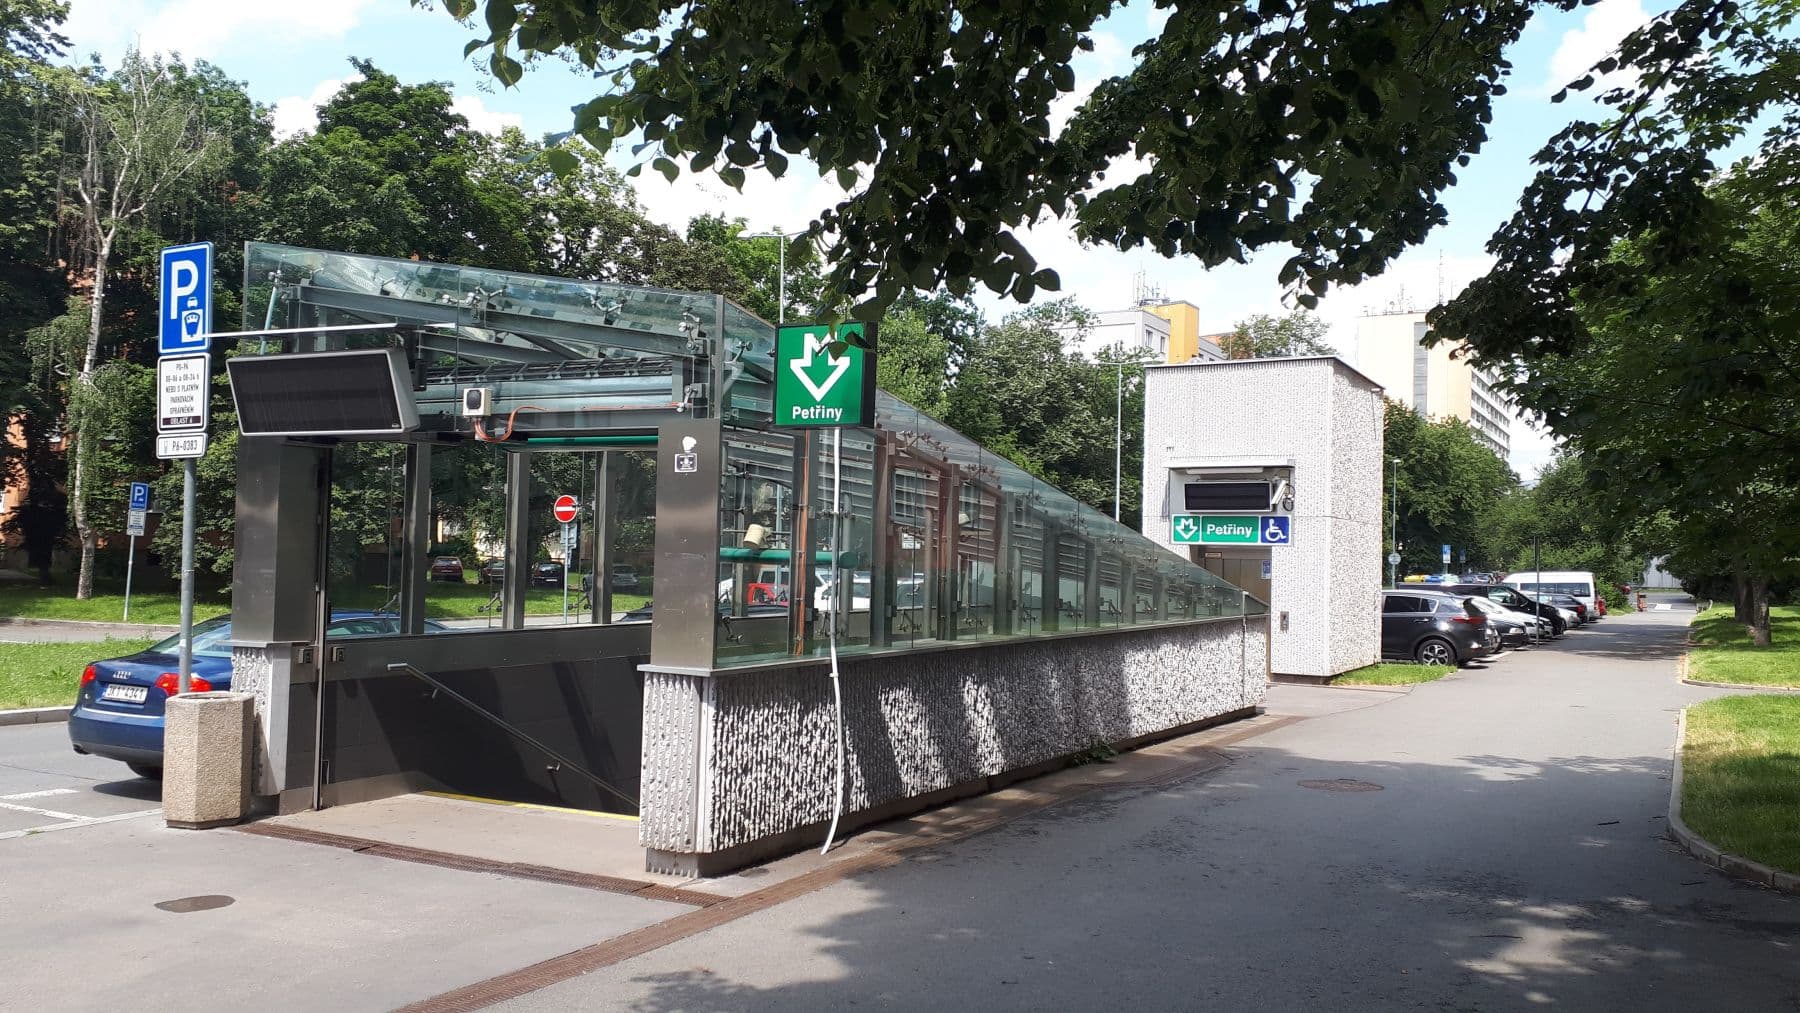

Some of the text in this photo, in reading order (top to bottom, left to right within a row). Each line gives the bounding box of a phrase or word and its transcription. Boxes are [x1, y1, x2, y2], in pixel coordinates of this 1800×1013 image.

[170, 260, 198, 320] P
[792, 404, 843, 422] Petřiny
[1206, 523, 1253, 538] Petřiny
